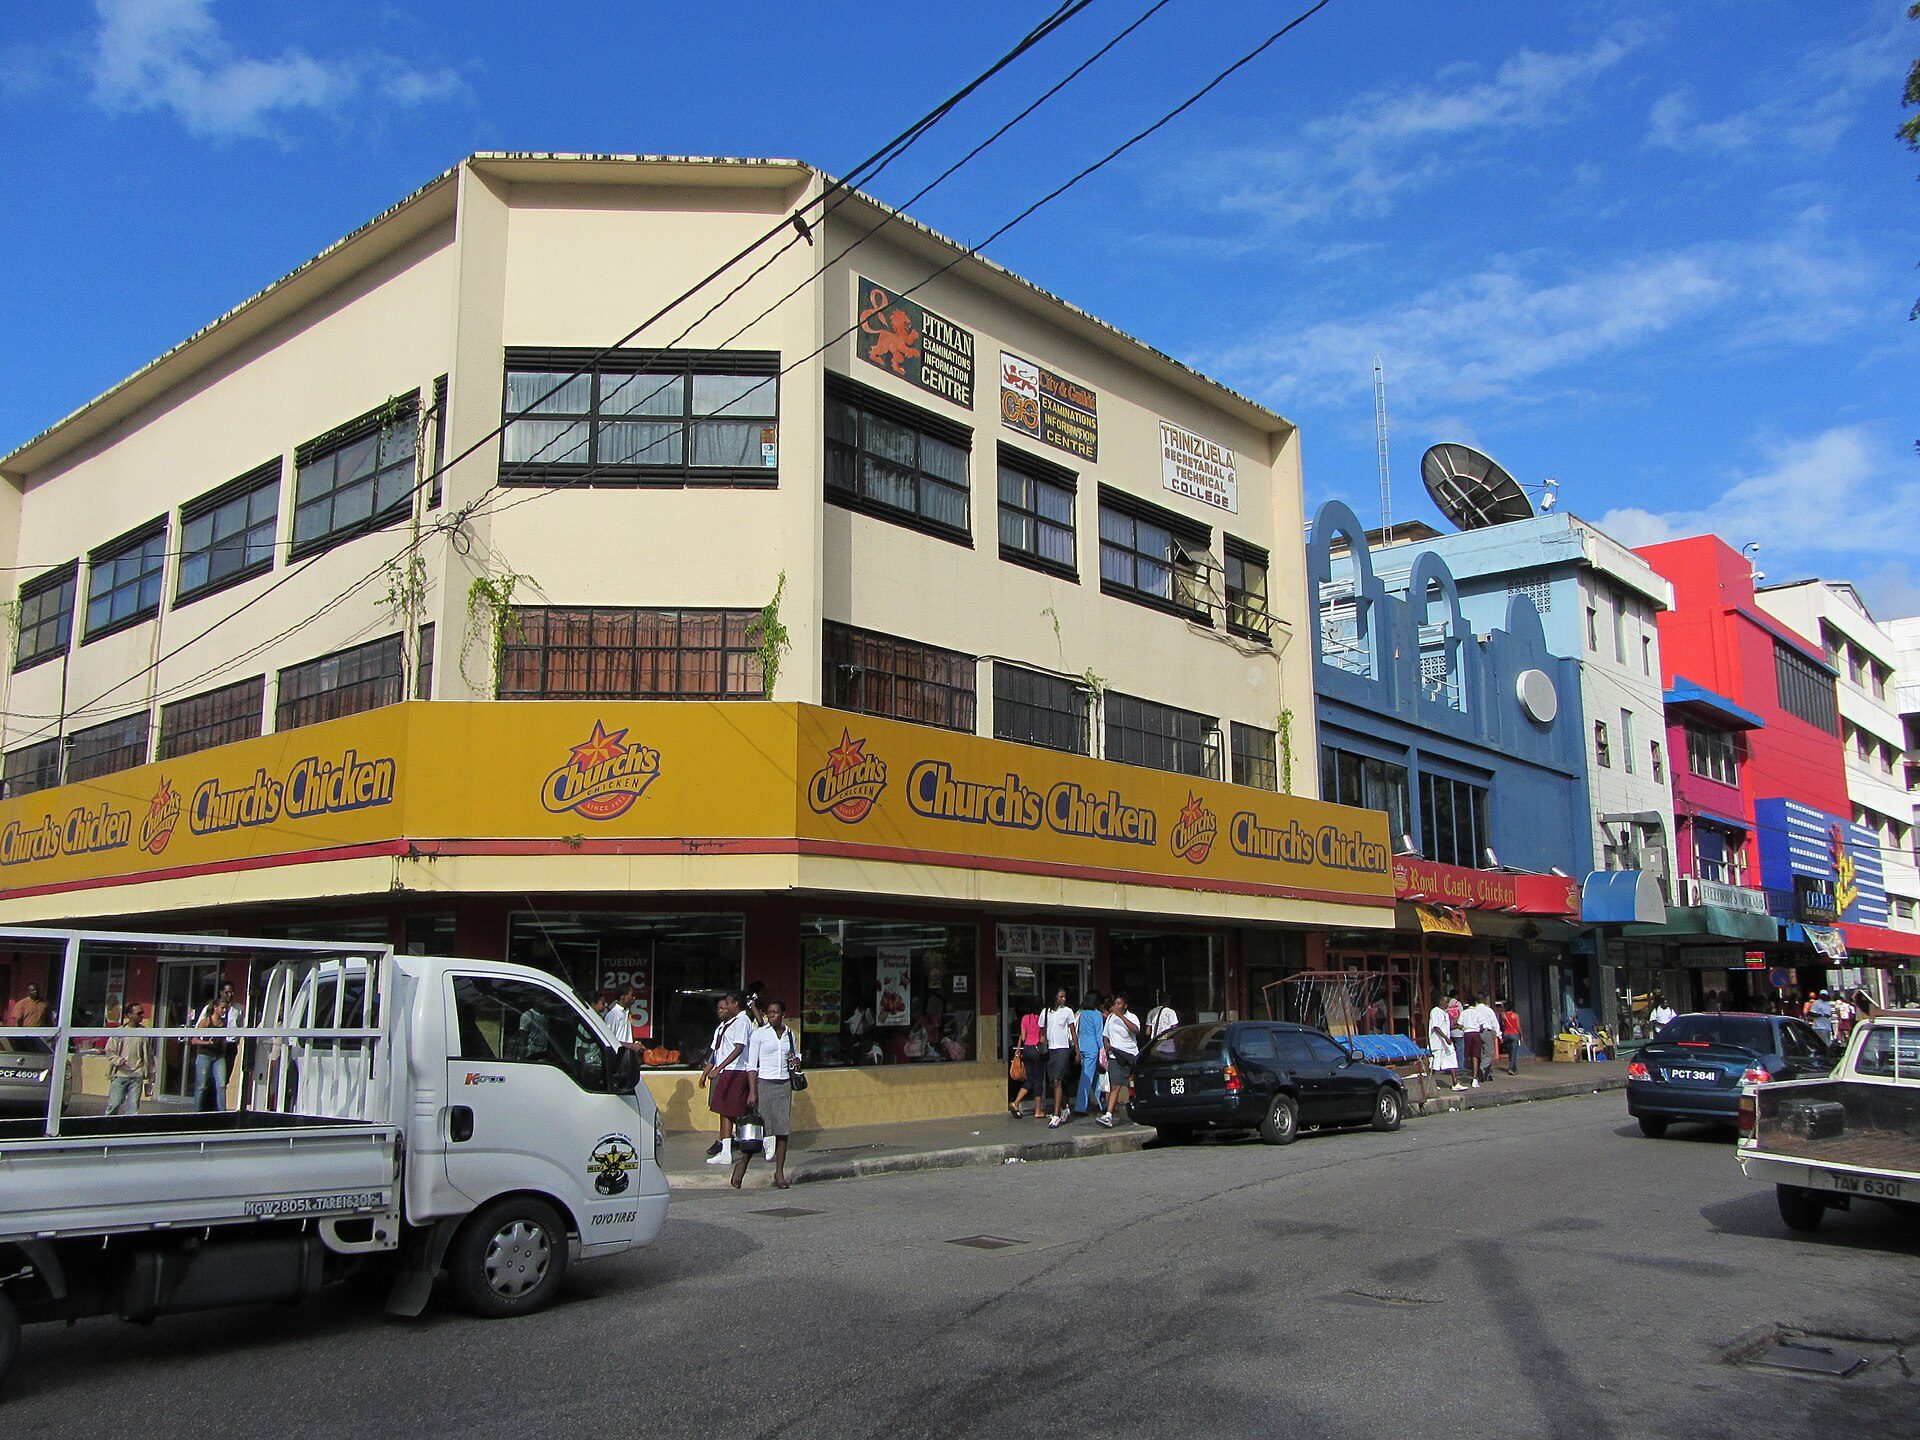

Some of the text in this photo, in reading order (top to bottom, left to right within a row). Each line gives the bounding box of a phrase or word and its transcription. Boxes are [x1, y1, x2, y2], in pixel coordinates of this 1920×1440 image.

[921, 312, 972, 358] PITMAN
[923, 337, 971, 371] EXAMINATIONS
[924, 352, 969, 384] INFORMATION
[921, 366, 970, 404] CENTRE
[1040, 371, 1059, 396] City
[1059, 381, 1067, 398] &
[1042, 397, 1096, 429] EXAMINATIONS
[1044, 412, 1095, 443] INFORMATION
[1047, 429, 1094, 457] CENTRE
[1161, 424, 1235, 470] TRINIZUELA
[1164, 447, 1224, 479] SECRETARIAL
[1172, 478, 1228, 508] COLLEGE
[1176, 465, 1226, 493] TECHNICAL
[189, 749, 396, 836] Church's Chicken
[541, 743, 661, 813] Church's
[587, 778, 639, 796] CHICKEN
[808, 754, 888, 814] Church's
[840, 786, 875, 800] CHICKEN
[587, 803, 609, 812] SINCE
[906, 760, 1156, 846] Church's Chicken
[0, 802, 131, 866] Church's Chicken
[1171, 808, 1217, 858] Church's
[1230, 811, 1387, 874] Church's Chicken
[1410, 867, 1514, 903] Royal Castle Chicken
[602, 958, 649, 967] TUESDAY
[604, 971, 646, 989] 2PC
[1171, 1078, 1184, 1087] PCB
[1171, 1085, 1184, 1094] 650
[1671, 1069, 1715, 1081] PCT 3841
[1832, 1175, 1900, 1197] TAW 6301
[591, 1211, 636, 1225] TOYO TIRES
